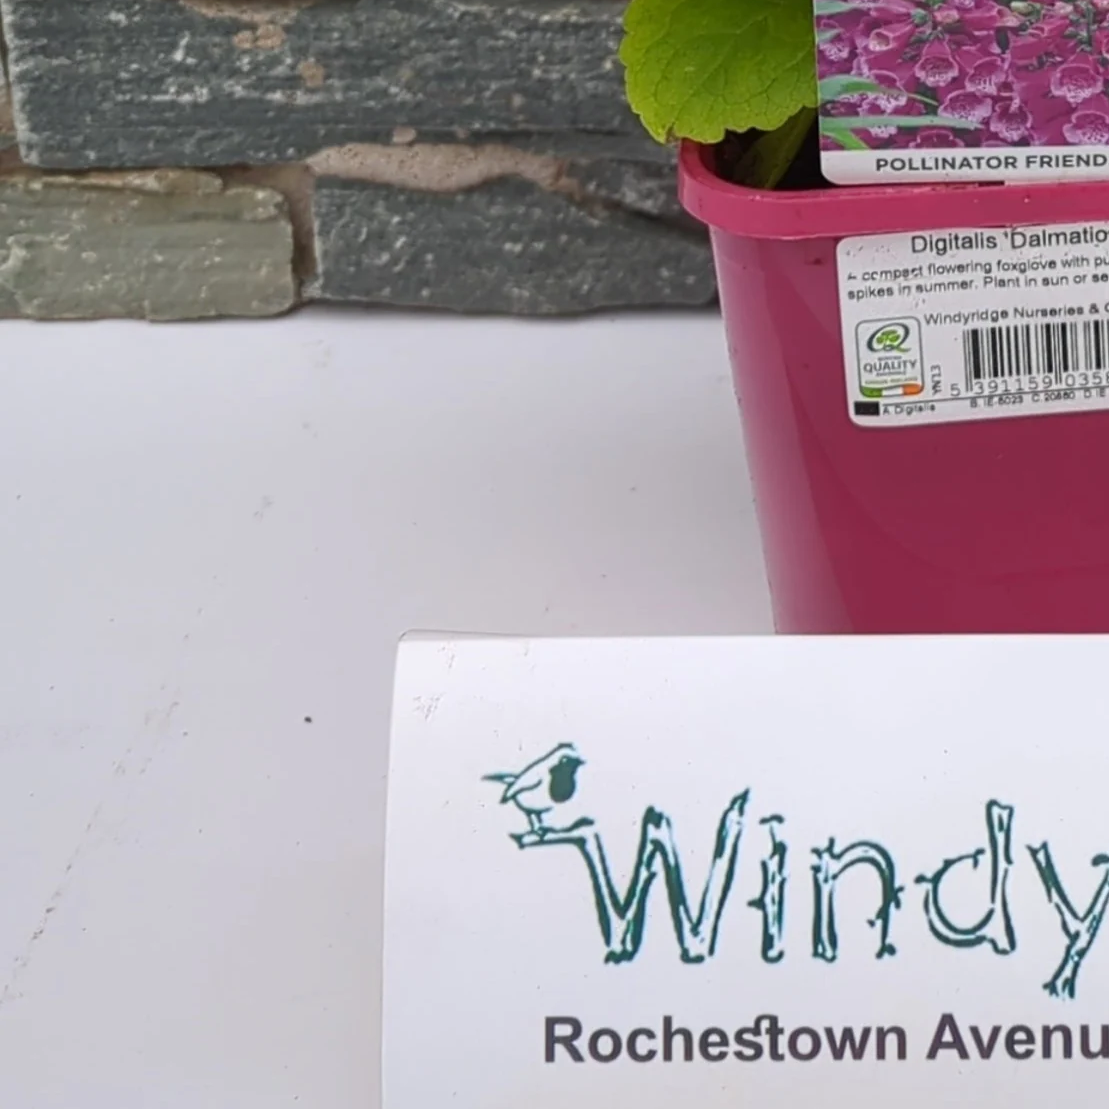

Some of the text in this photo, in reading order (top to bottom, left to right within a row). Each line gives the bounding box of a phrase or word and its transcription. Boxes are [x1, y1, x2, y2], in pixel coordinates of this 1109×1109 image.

[875, 155, 1018, 171] POLLINATOR
[911, 233, 998, 256] Digitalis
[927, 259, 993, 279] flowering
[997, 256, 1057, 274] foxglove
[1061, 255, 1090, 268] with
[847, 288, 895, 302] spikes
[915, 278, 979, 293] summer.
[983, 274, 1021, 288] Plant
[1024, 274, 1038, 286] in
[1042, 272, 1069, 284] sun
[1073, 272, 1088, 284] or
[924, 305, 1009, 325] Windyridge
[1013, 302, 1085, 317] Nurseries
[1089, 303, 1100, 315] &
[863, 359, 917, 373] QUALITY
[544, 1014, 908, 1064] Rochestown
